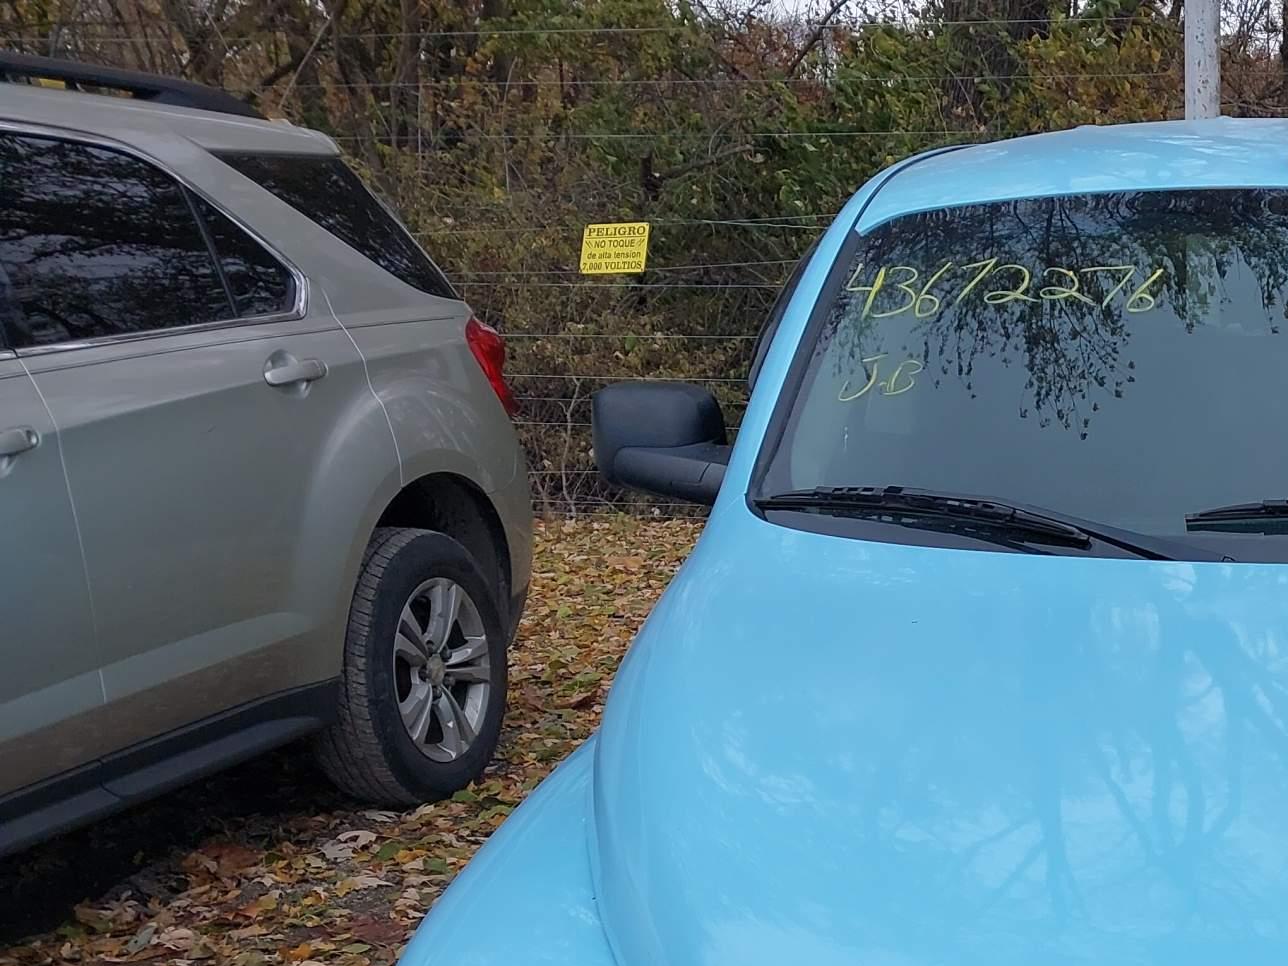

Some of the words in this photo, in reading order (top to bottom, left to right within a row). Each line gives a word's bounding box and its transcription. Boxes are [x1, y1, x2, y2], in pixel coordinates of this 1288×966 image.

[587, 225, 646, 236] PELIGRO
[594, 240, 606, 248] NO
[608, 239, 635, 248] TOQUE
[587, 251, 597, 260] de
[598, 251, 612, 259] alta
[582, 262, 602, 272] 7,000
[604, 261, 642, 270] VOLTIOS
[846, 257, 1165, 320] 43672276
